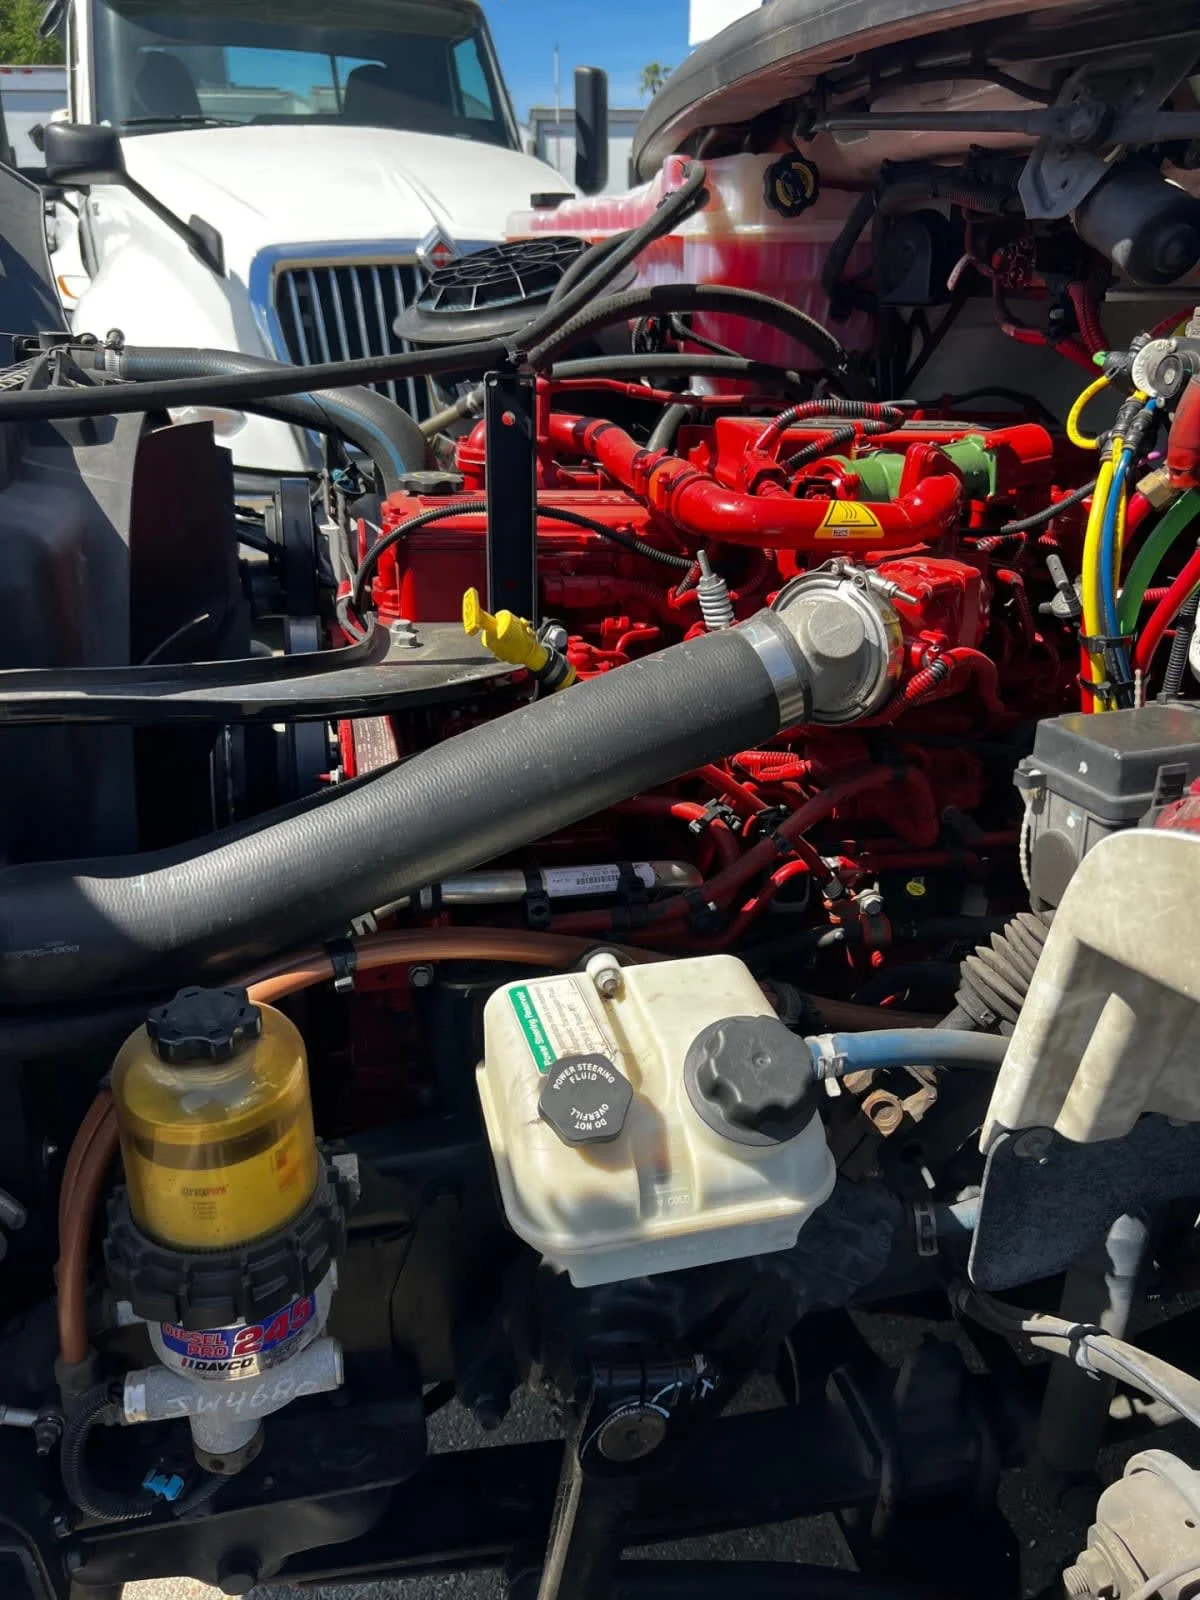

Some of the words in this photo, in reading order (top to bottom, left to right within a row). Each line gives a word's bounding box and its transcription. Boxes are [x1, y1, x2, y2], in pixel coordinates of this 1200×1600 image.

[515, 991, 534, 1020] Reservoir
[527, 1018, 545, 1046] Steering
[553, 1065, 576, 1090] POWER
[577, 1063, 615, 1084] STEERING
[569, 1072, 597, 1084] FLUID
[570, 1103, 609, 1121] OVERFILL
[573, 1121, 593, 1131] NOT
[594, 1118, 608, 1129] DO
[162, 1321, 227, 1346] DIESEL
[187, 1343, 229, 1358] PRO
[194, 1356, 254, 1372] DAVCO
